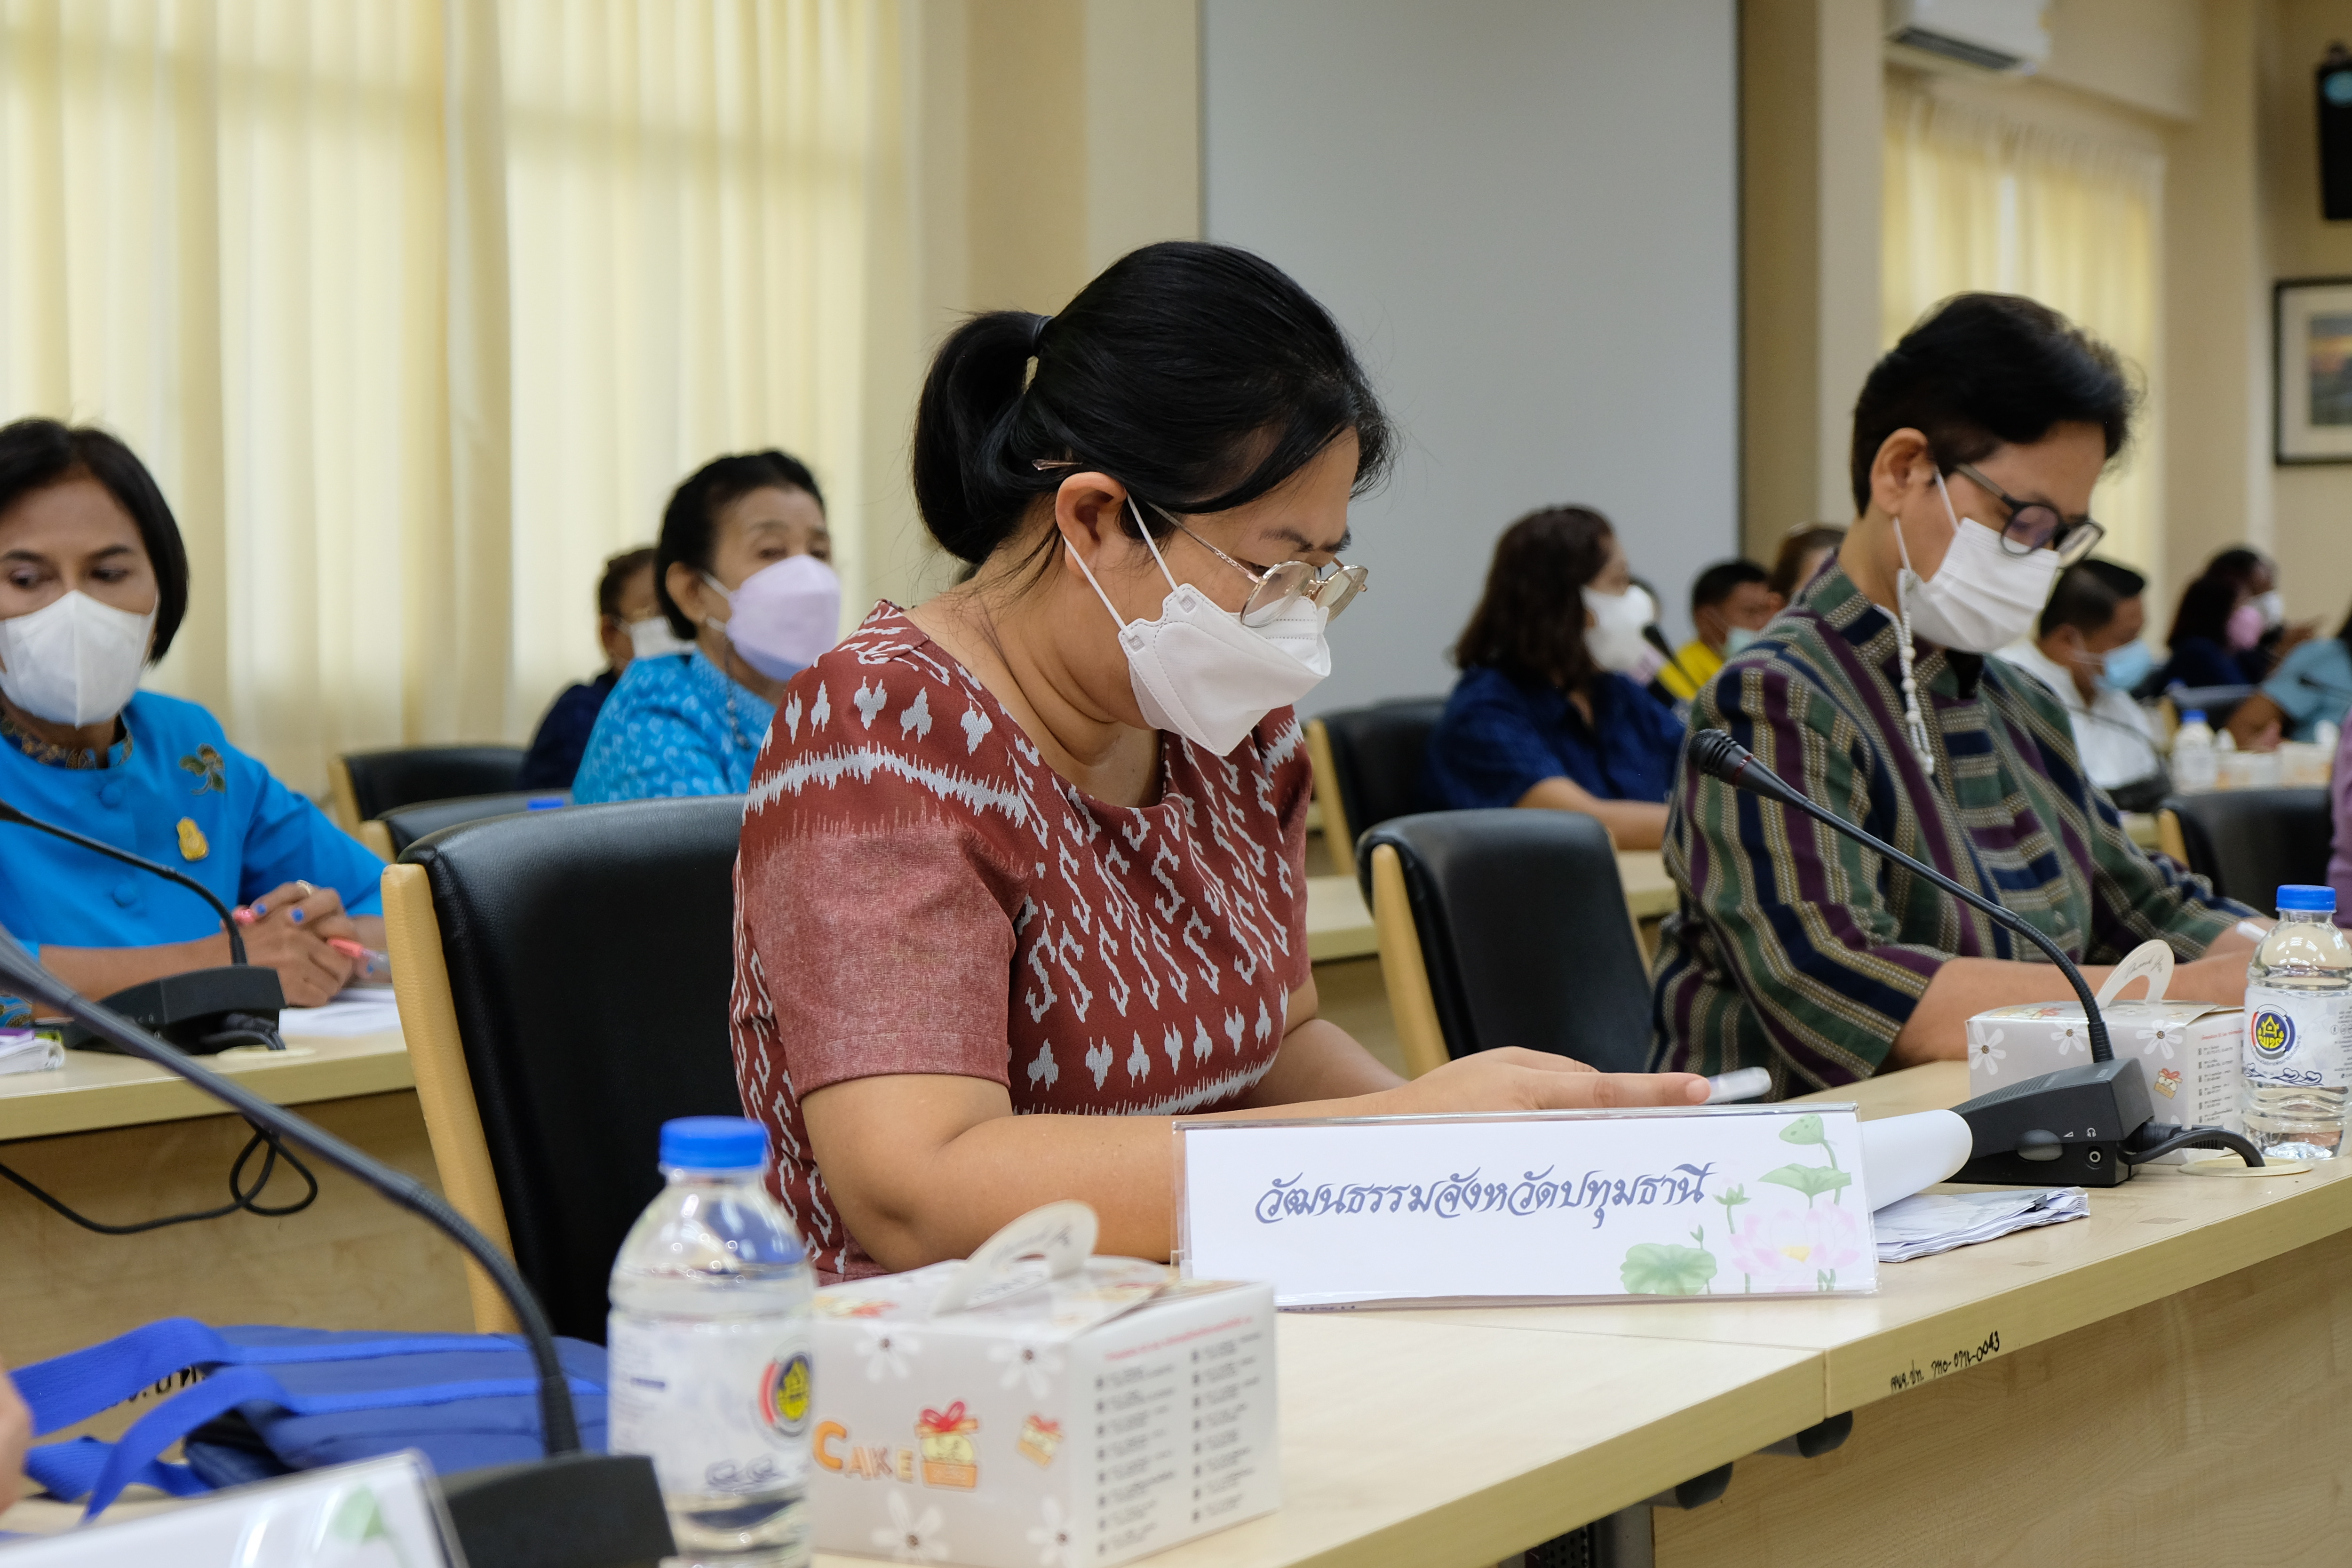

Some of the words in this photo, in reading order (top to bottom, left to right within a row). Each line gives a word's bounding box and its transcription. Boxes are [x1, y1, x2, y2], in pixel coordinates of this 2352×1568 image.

[1254, 1162, 1717, 1229] วัฒนธรรมจังหวัดปทุมธานี
[812, 1420, 914, 1482] CAKE
